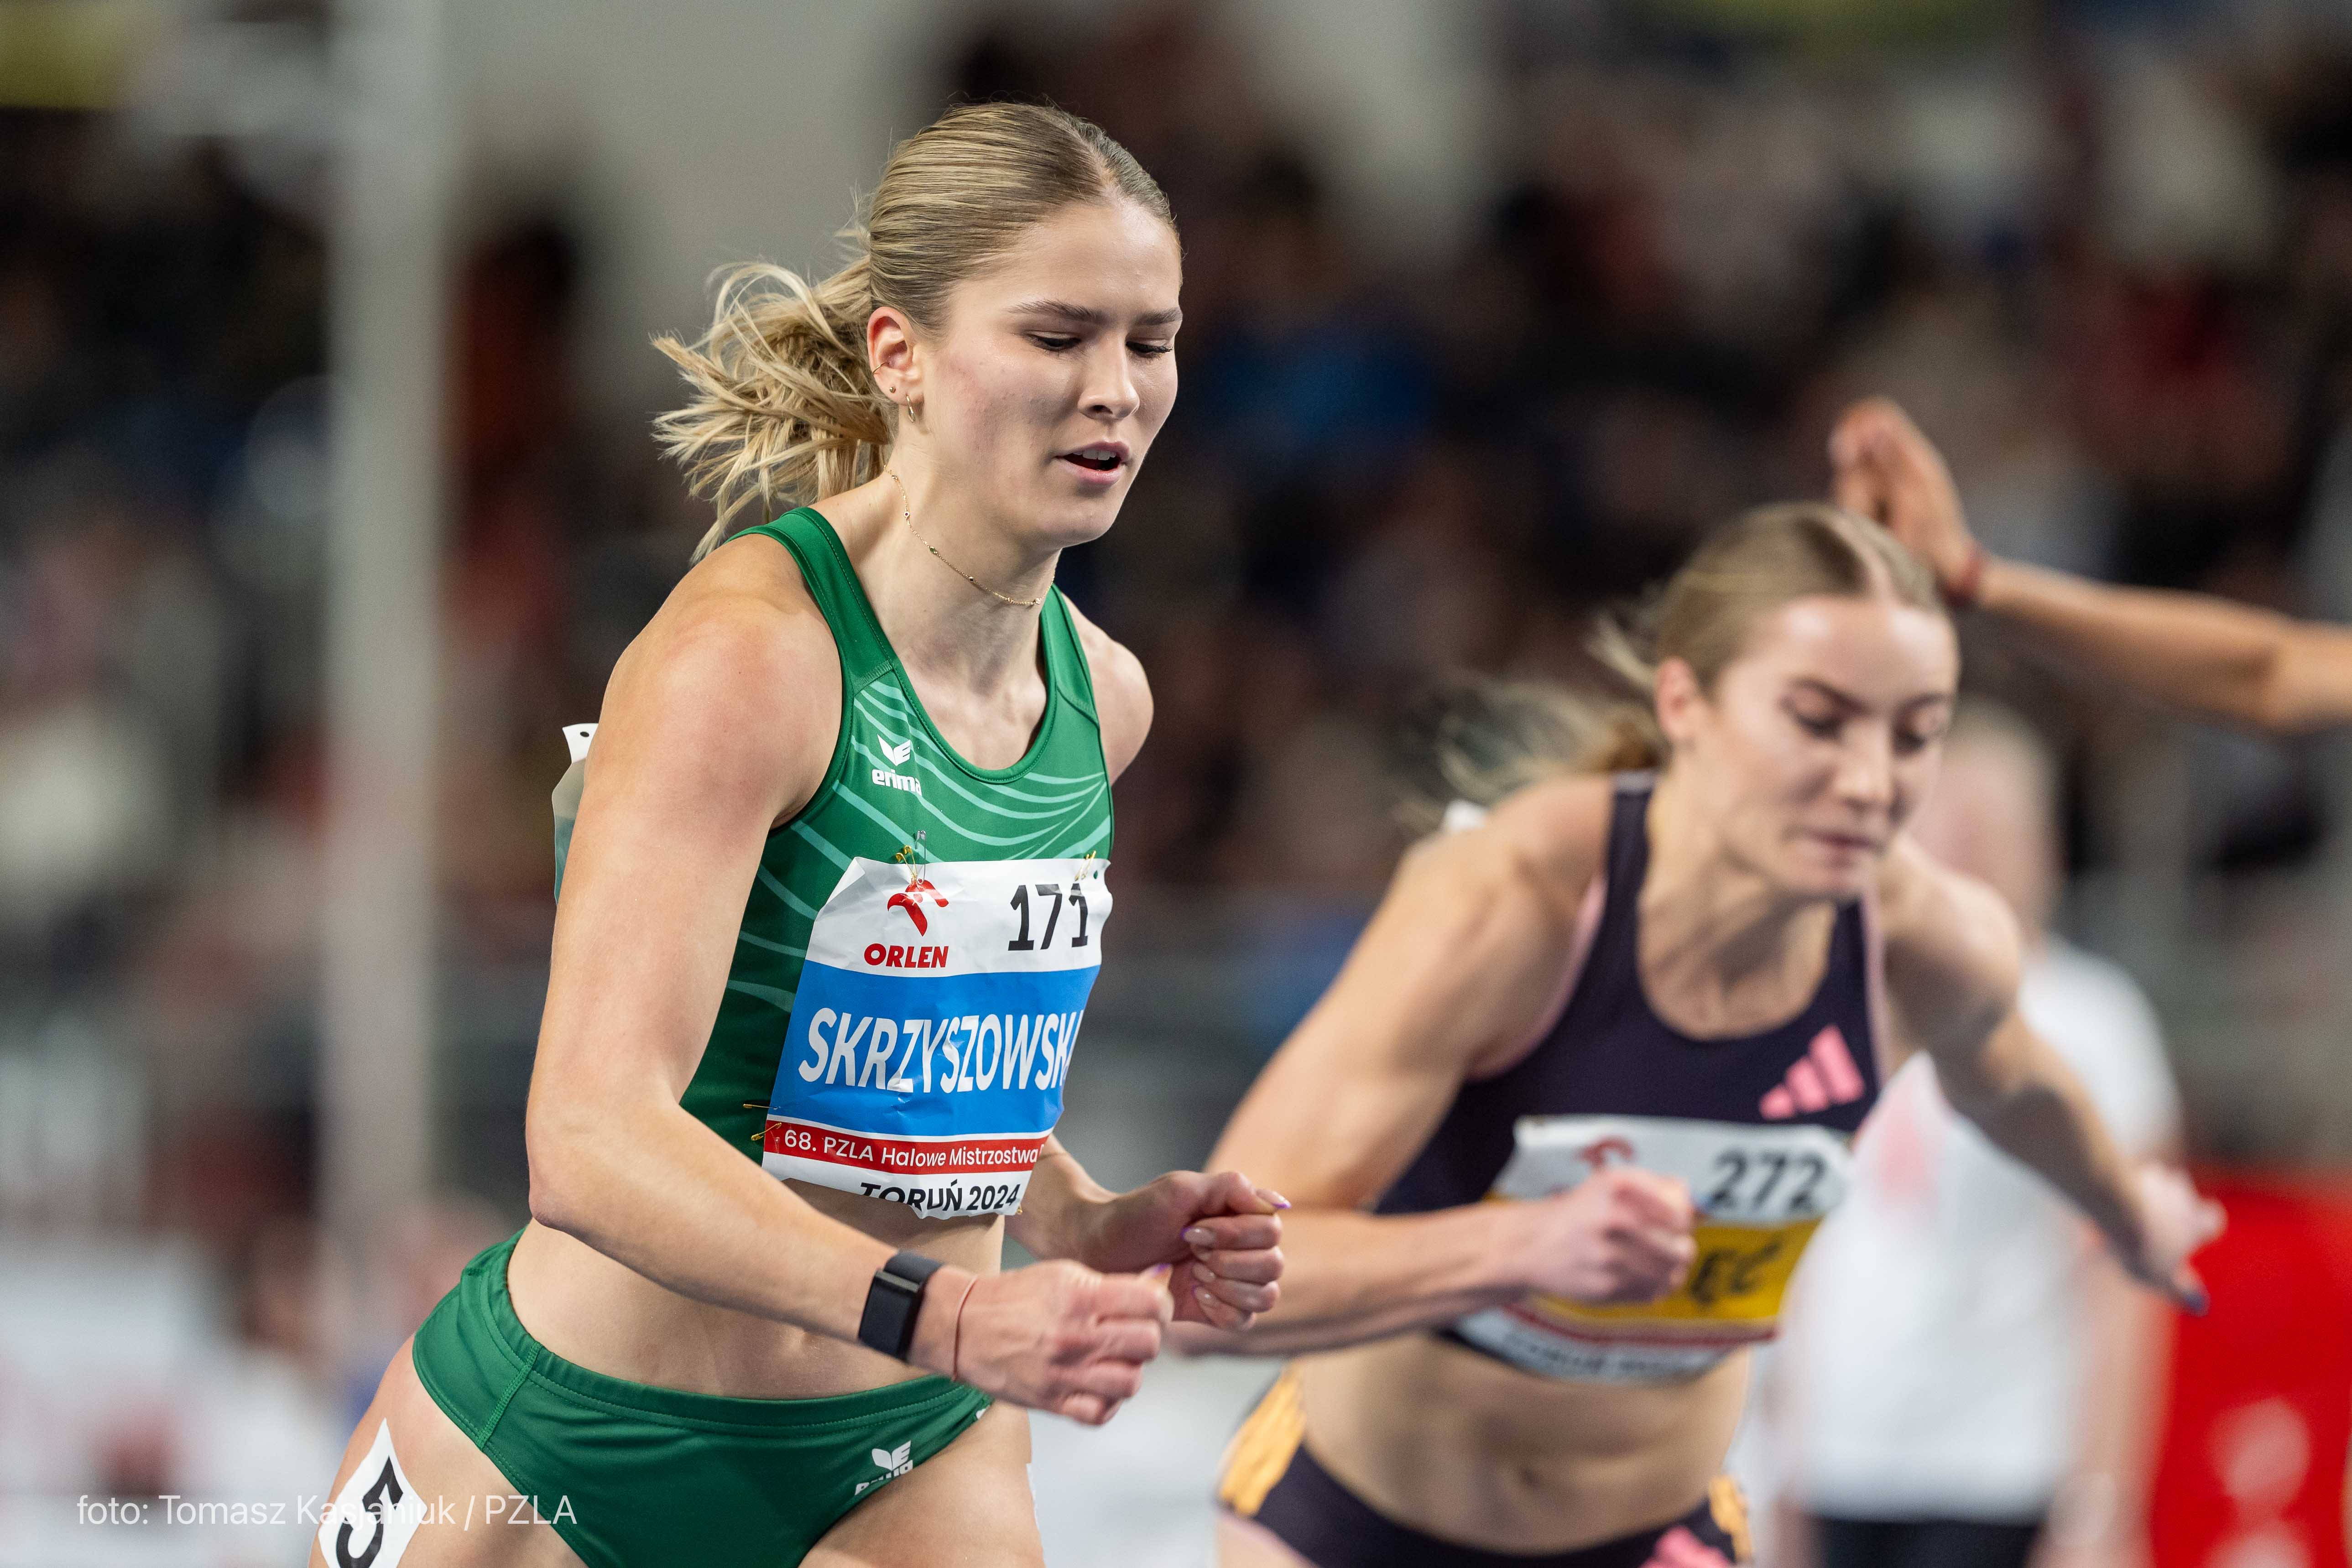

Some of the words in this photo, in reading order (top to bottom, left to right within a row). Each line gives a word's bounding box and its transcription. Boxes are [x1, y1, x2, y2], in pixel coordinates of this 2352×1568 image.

[872, 769, 922, 796] erima
[1008, 882, 1088, 951] 171
[864, 943, 949, 969] ORLEN
[785, 1130, 817, 1152] 68.
[824, 1136, 874, 1162] PZLA
[881, 1147, 946, 1167] Halowe
[949, 1146, 1038, 1166] Mistrzostwa
[966, 1184, 1021, 1211] 2024
[1713, 1147, 1826, 1212] 272
[336, 1455, 403, 1568] 5
